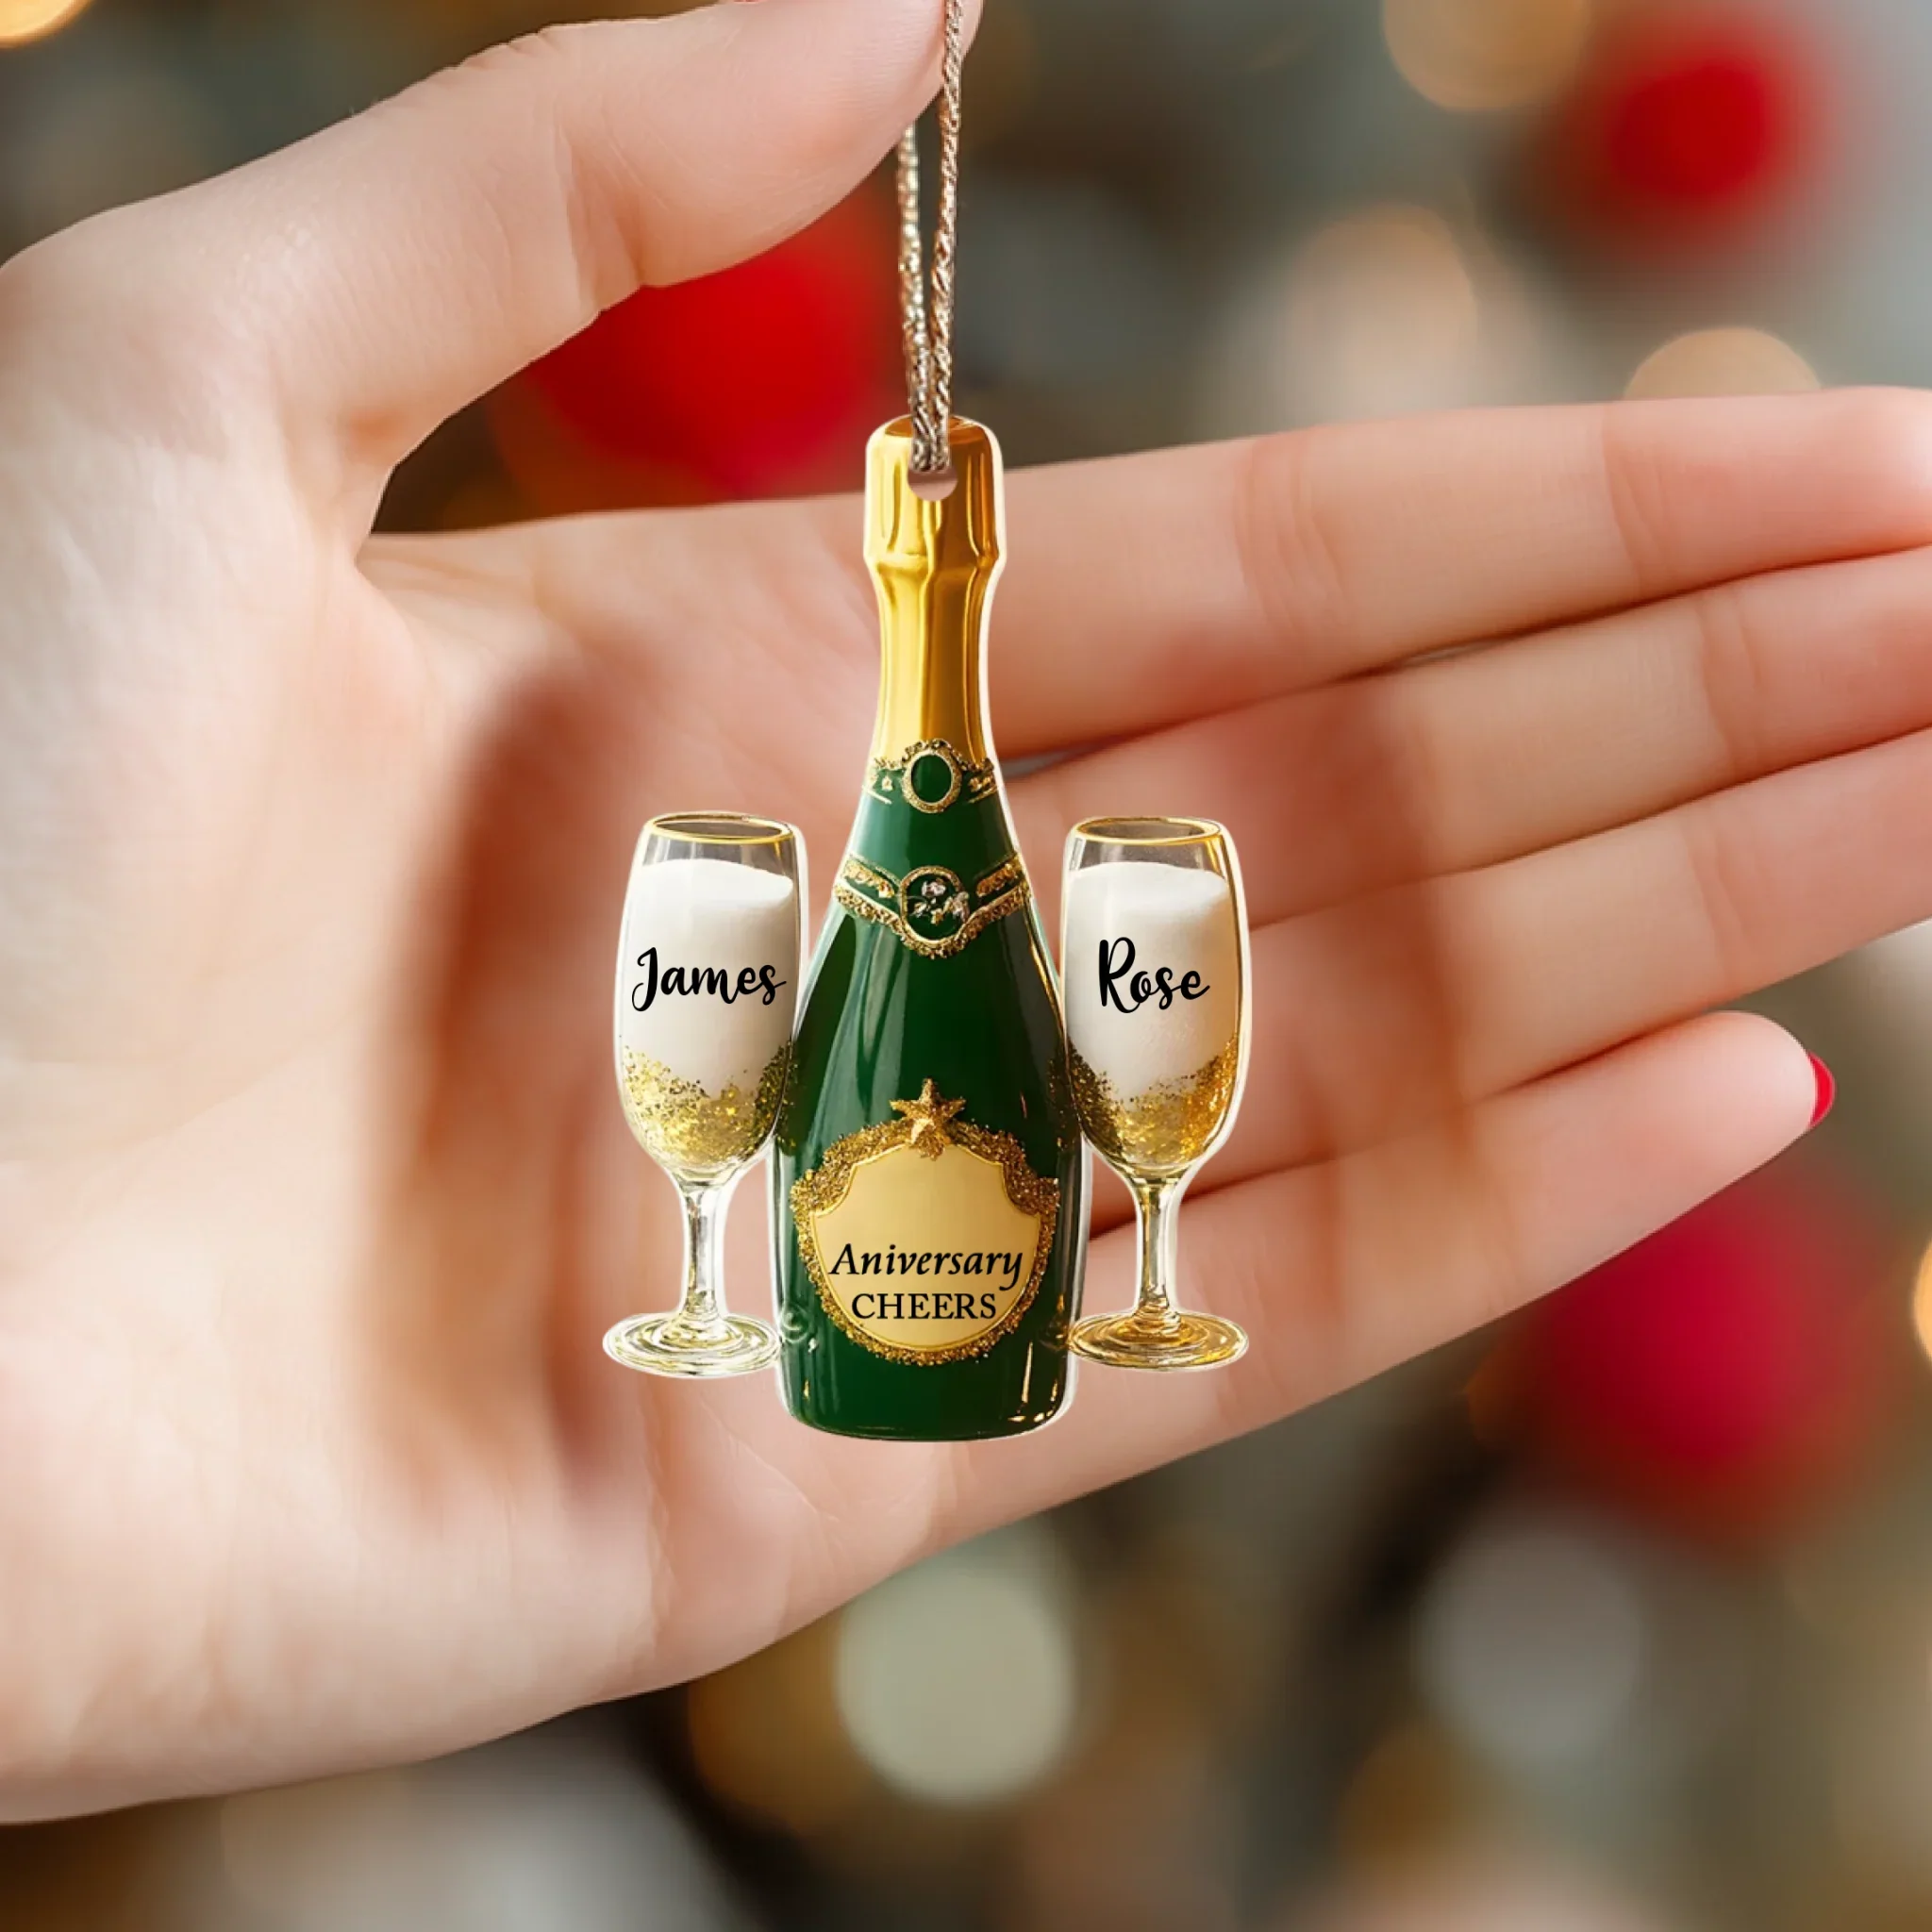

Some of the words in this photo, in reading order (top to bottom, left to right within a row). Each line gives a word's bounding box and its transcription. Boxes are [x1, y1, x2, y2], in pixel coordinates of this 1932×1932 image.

[631, 946, 788, 1012] James
[1098, 937, 1211, 1014] Rose
[827, 1242, 1024, 1291] Aniversary
[851, 1292, 996, 1320] CHEERS
